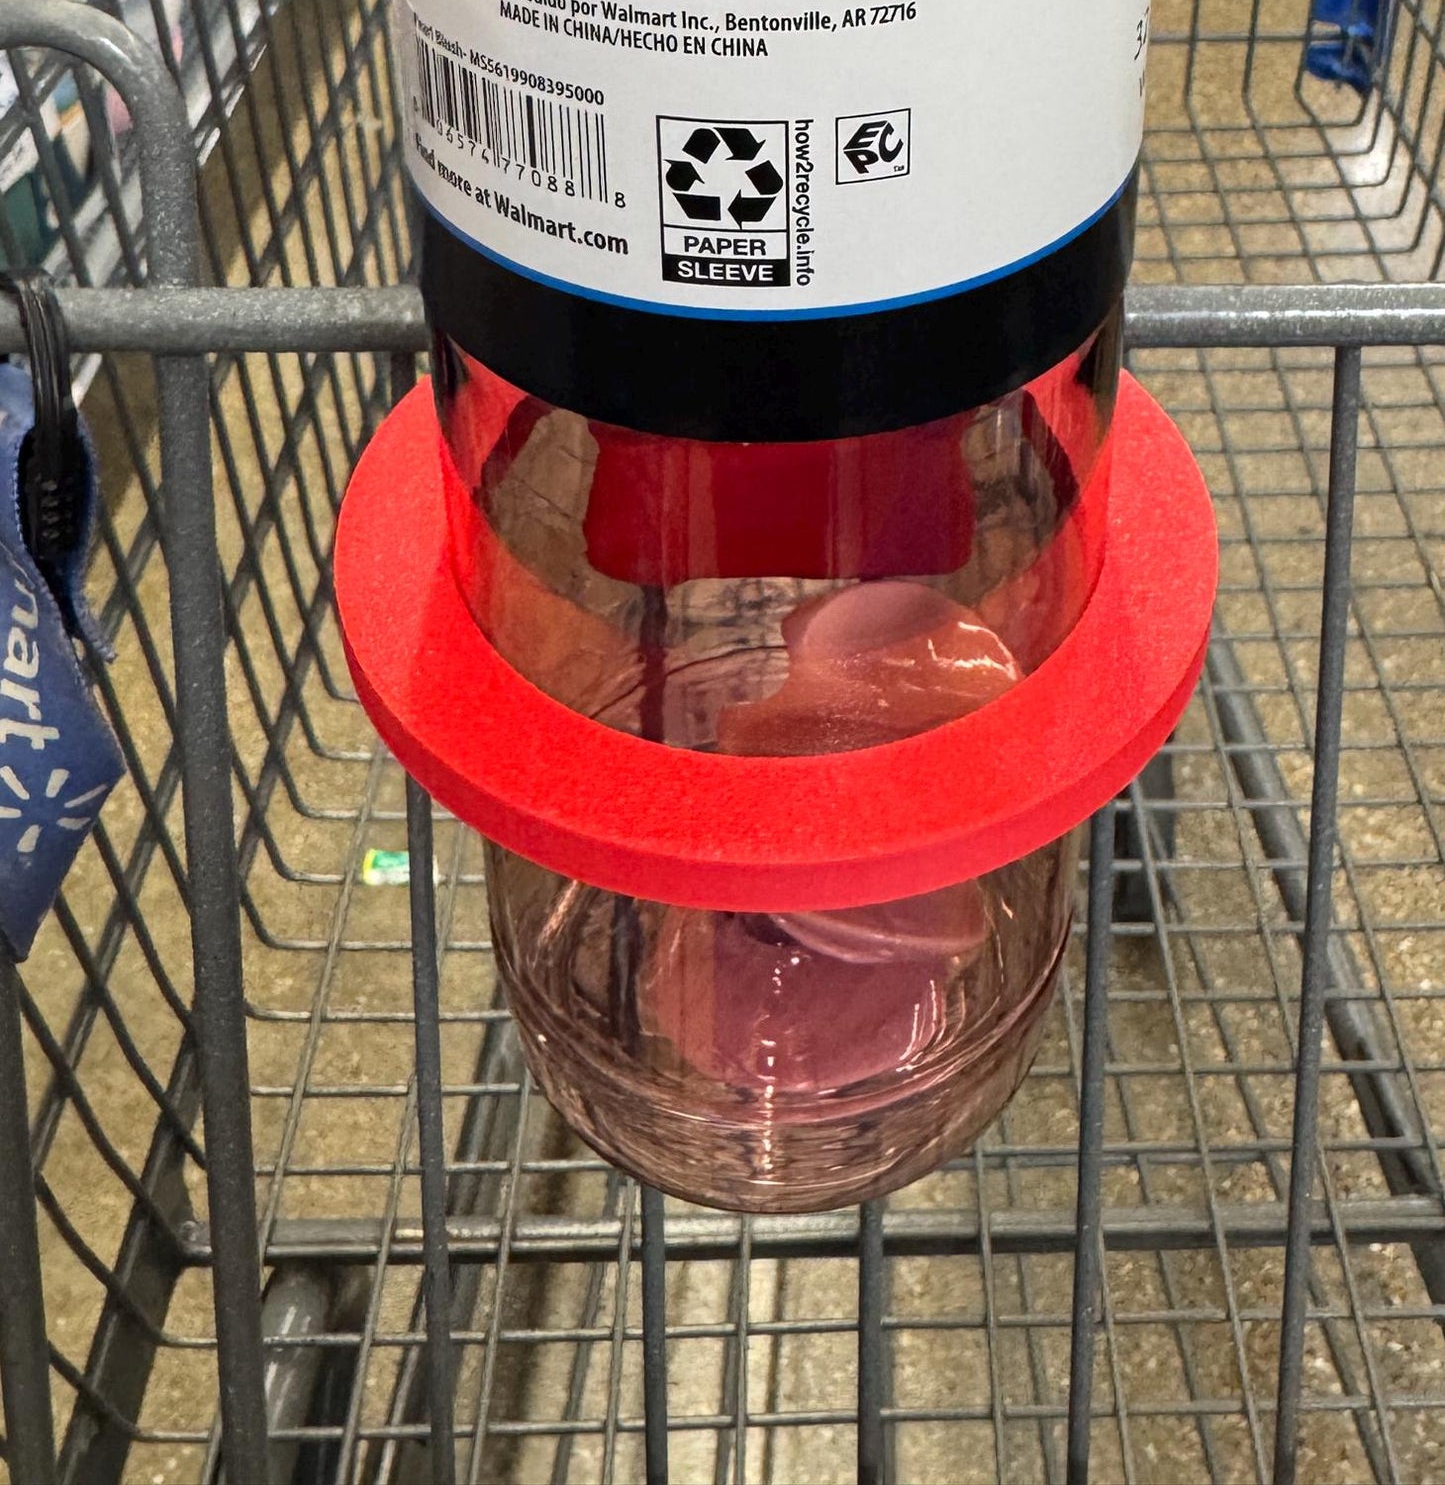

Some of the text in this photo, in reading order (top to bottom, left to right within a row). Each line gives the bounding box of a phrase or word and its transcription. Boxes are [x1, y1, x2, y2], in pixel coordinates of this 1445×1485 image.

[500, 0, 768, 57] MADE IN CHINA/HECHO EN CHINA
[571, 0, 597, 17] por
[601, 0, 677, 29] Walmart
[681, 11, 720, 34] Inc.,
[725, 11, 837, 32] Bentonville,
[841, 8, 866, 28] AR
[869, 1, 917, 26] 72716
[470, 49, 604, 106] MS5619908395000
[438, 160, 472, 197] more
[475, 187, 491, 209] at
[494, 191, 629, 255] Walmart.com
[792, 119, 814, 287] how2recycle.info
[677, 261, 774, 282] SLEEVE
[684, 235, 767, 257] PAPER
